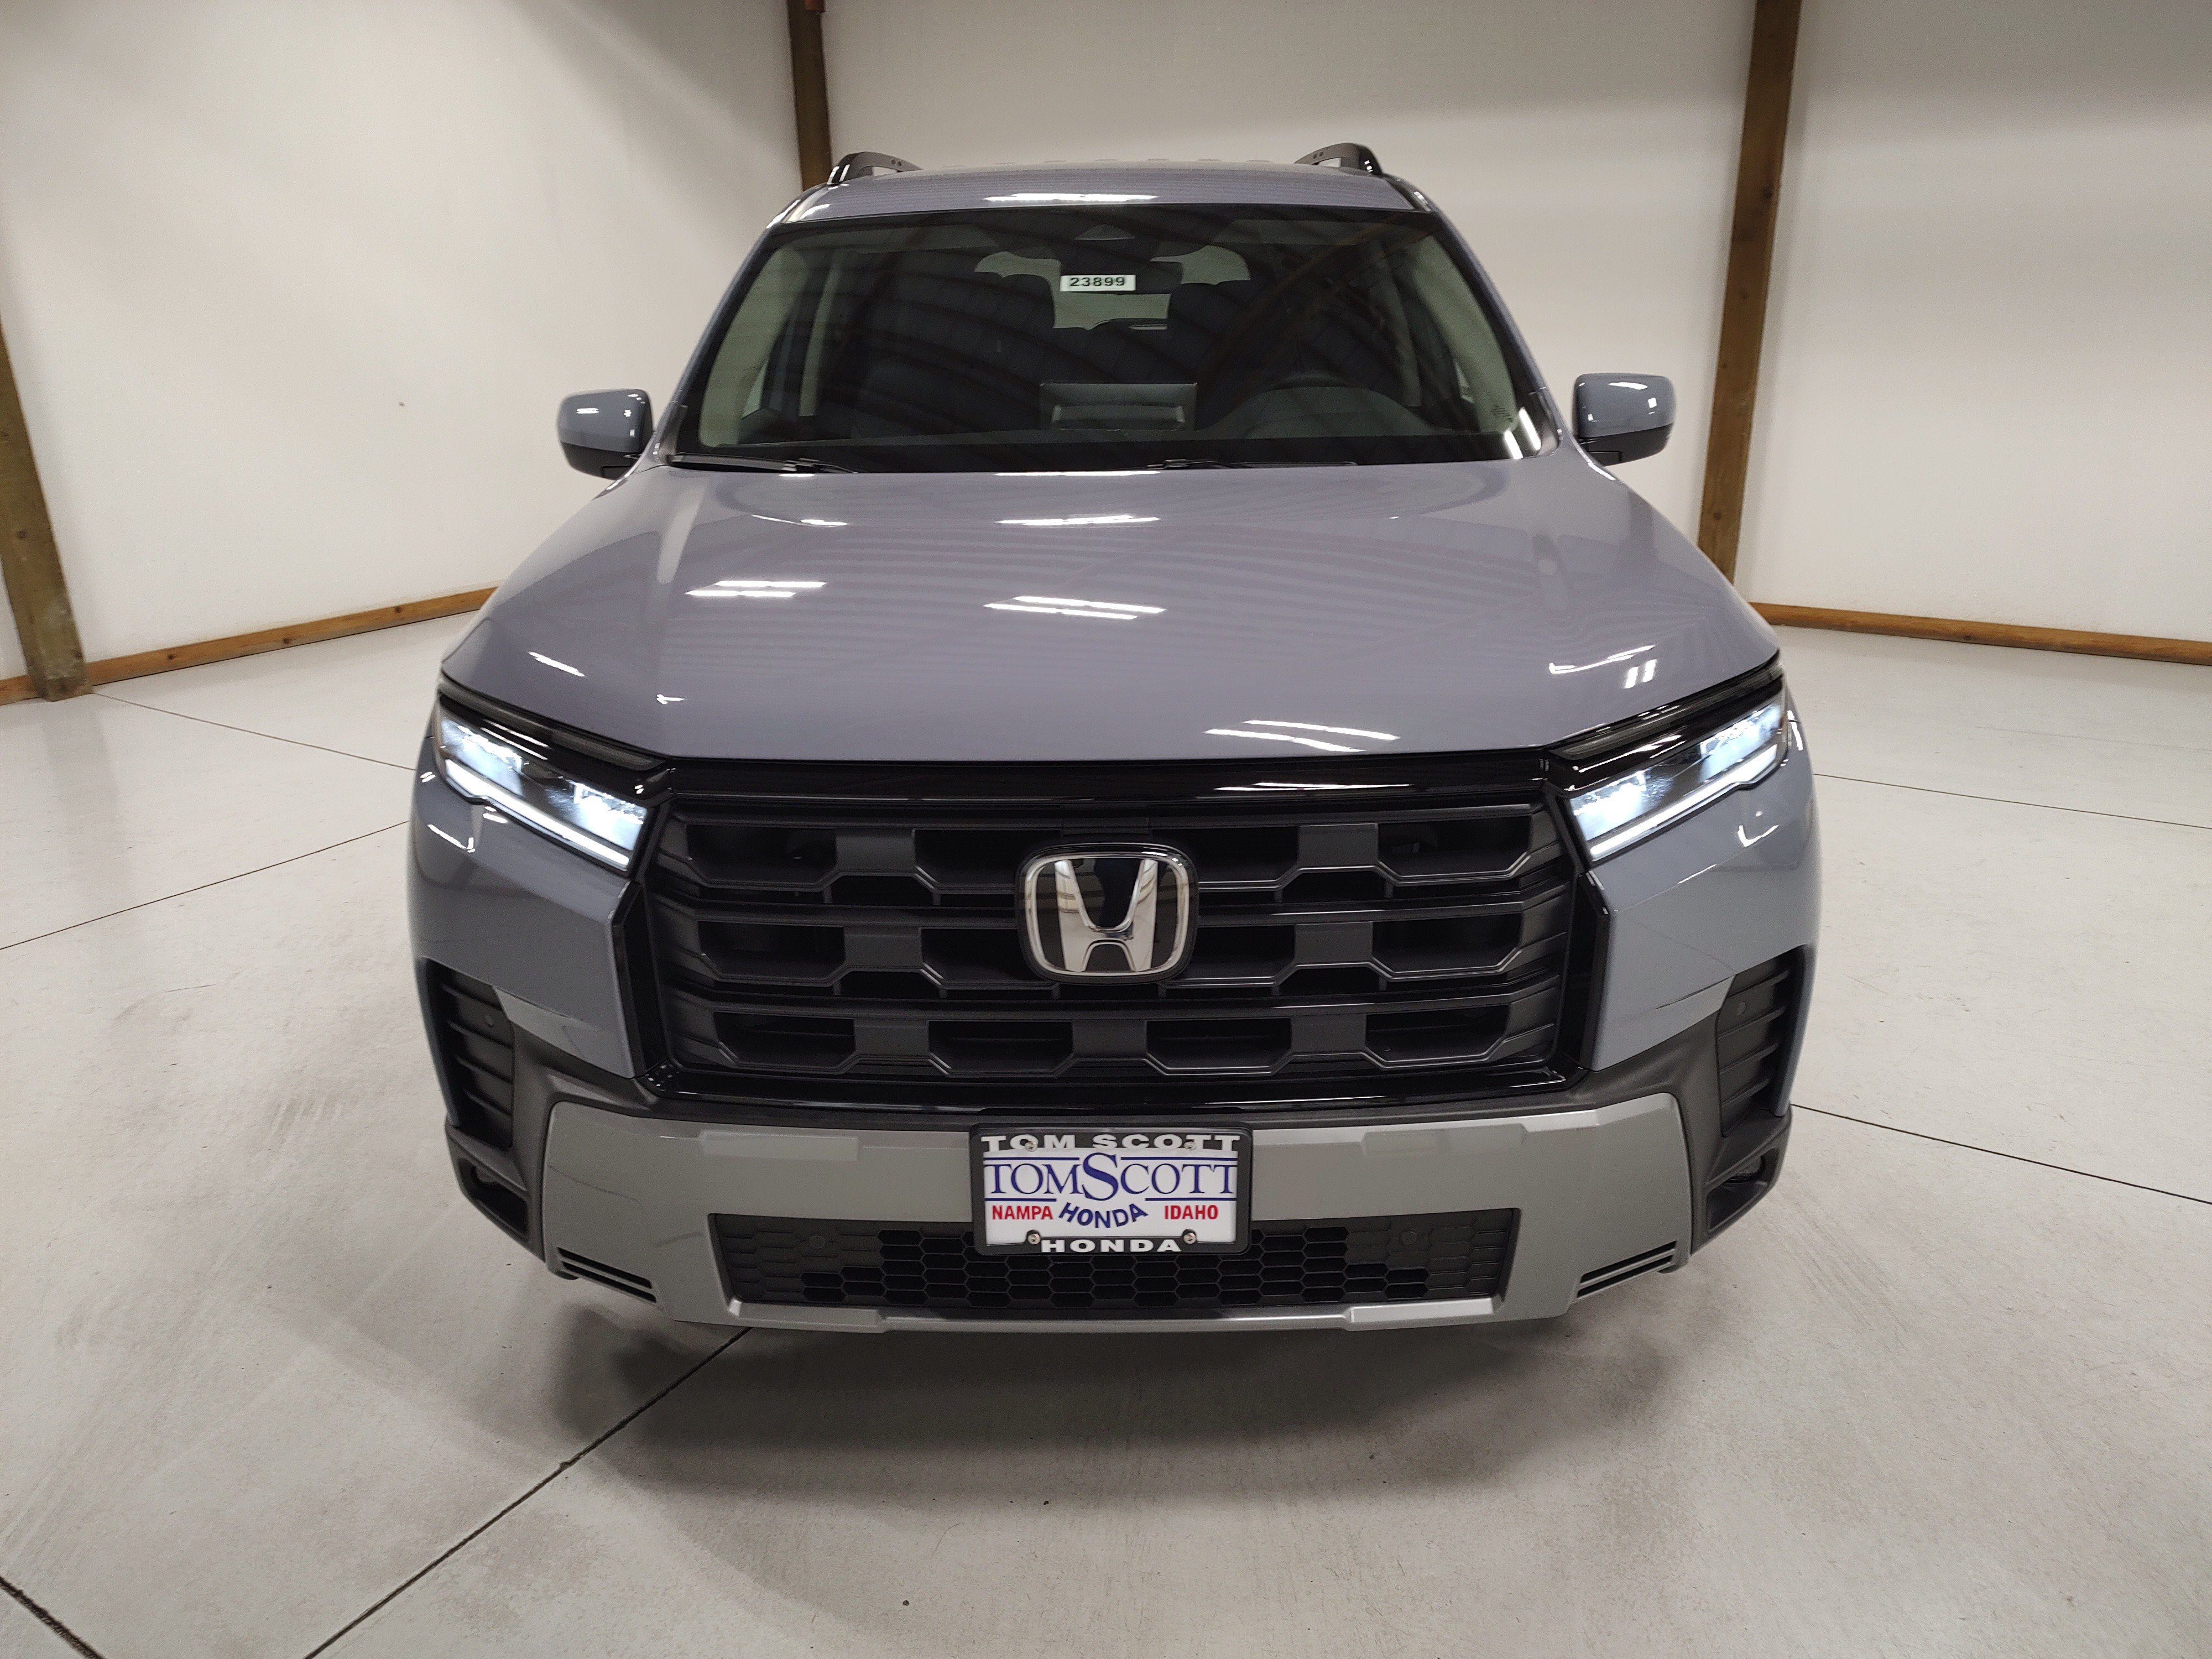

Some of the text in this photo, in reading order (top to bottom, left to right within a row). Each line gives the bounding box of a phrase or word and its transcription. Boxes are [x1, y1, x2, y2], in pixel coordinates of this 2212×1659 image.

[1070, 277, 1125, 286] 23899
[981, 1134, 1240, 1152] TOM SCOTT
[992, 1205, 1053, 1220] NAMPA
[1058, 1202, 1149, 1228] HONDA
[1164, 1204, 1219, 1220] IDAHO
[1041, 1239, 1182, 1253] HONDA
